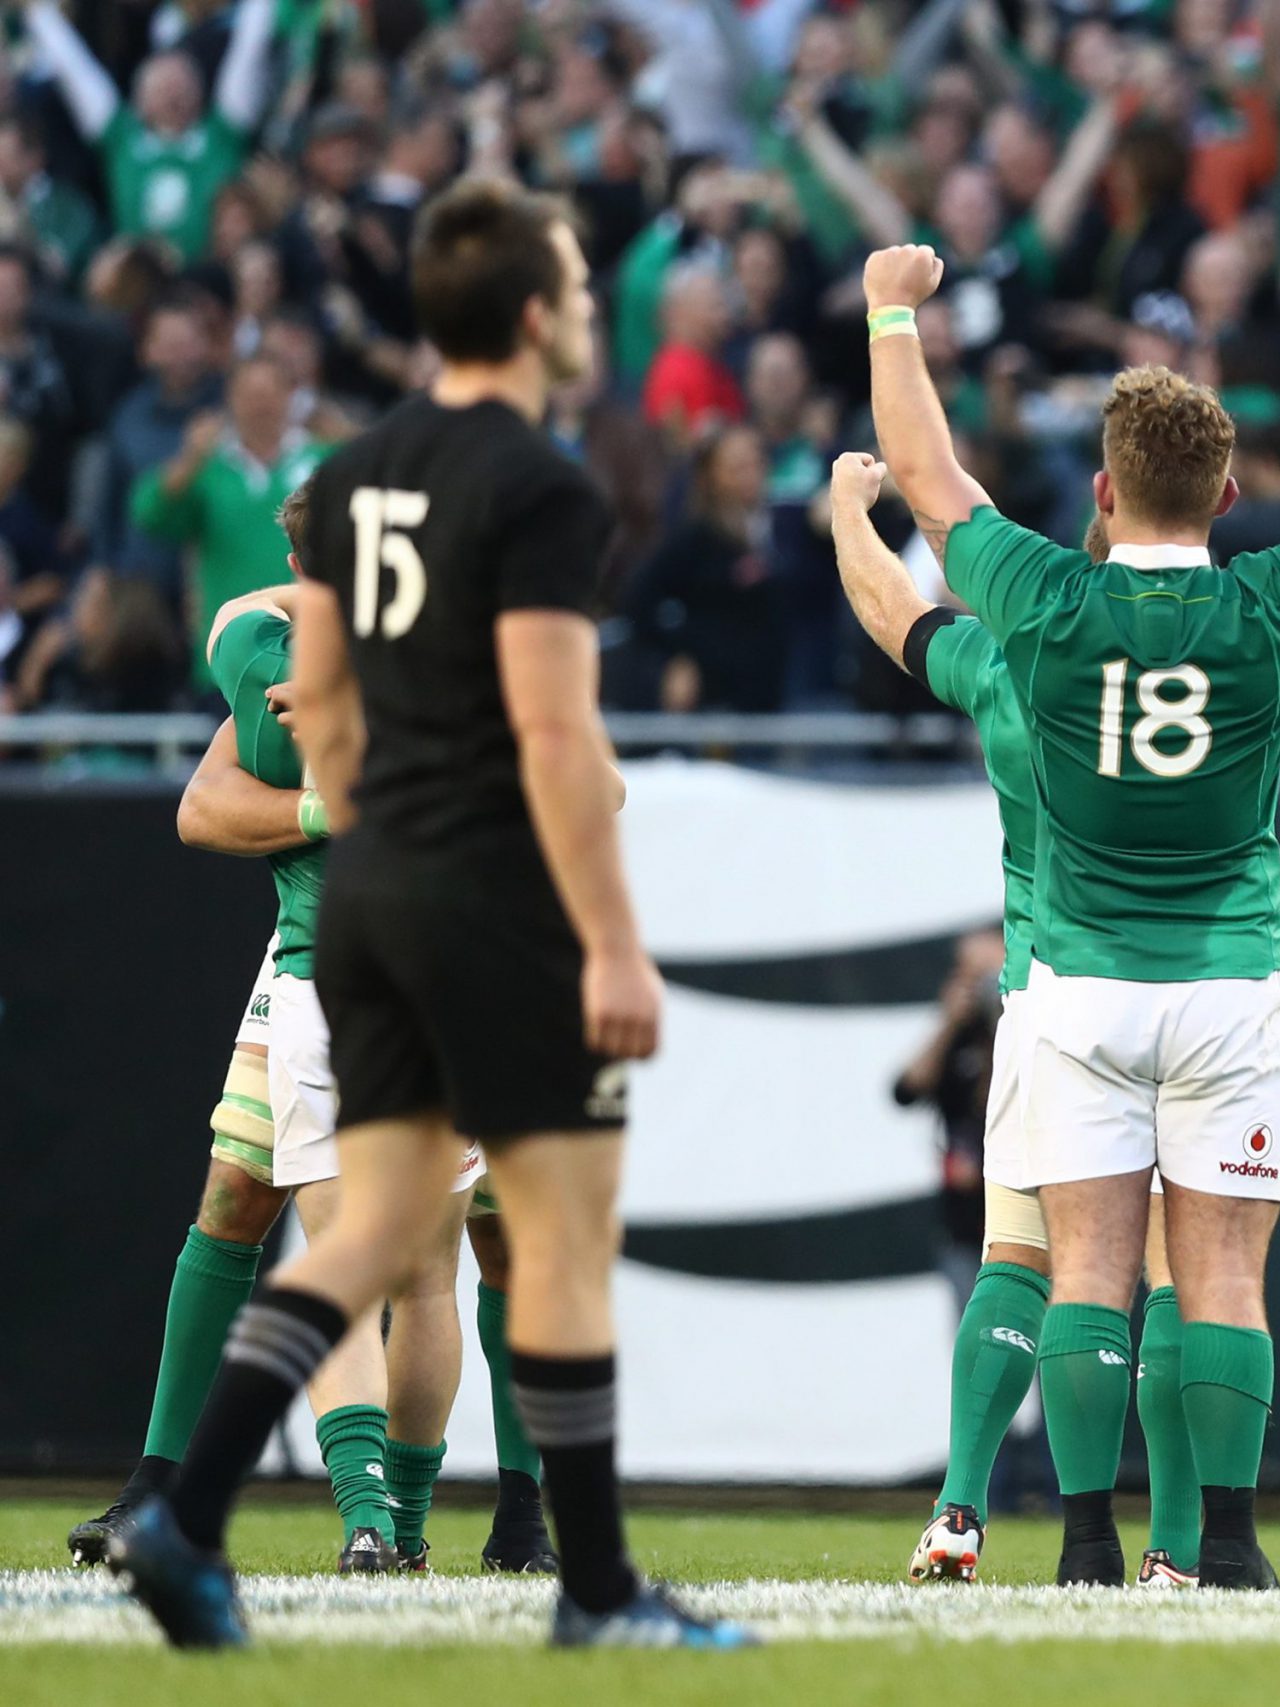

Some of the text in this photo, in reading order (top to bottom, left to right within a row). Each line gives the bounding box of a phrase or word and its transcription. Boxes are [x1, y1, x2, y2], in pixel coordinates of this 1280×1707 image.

[349, 485, 431, 641] 15
[1097, 657, 1213, 777] 18
[1219, 1161, 1279, 1179] vodafone
